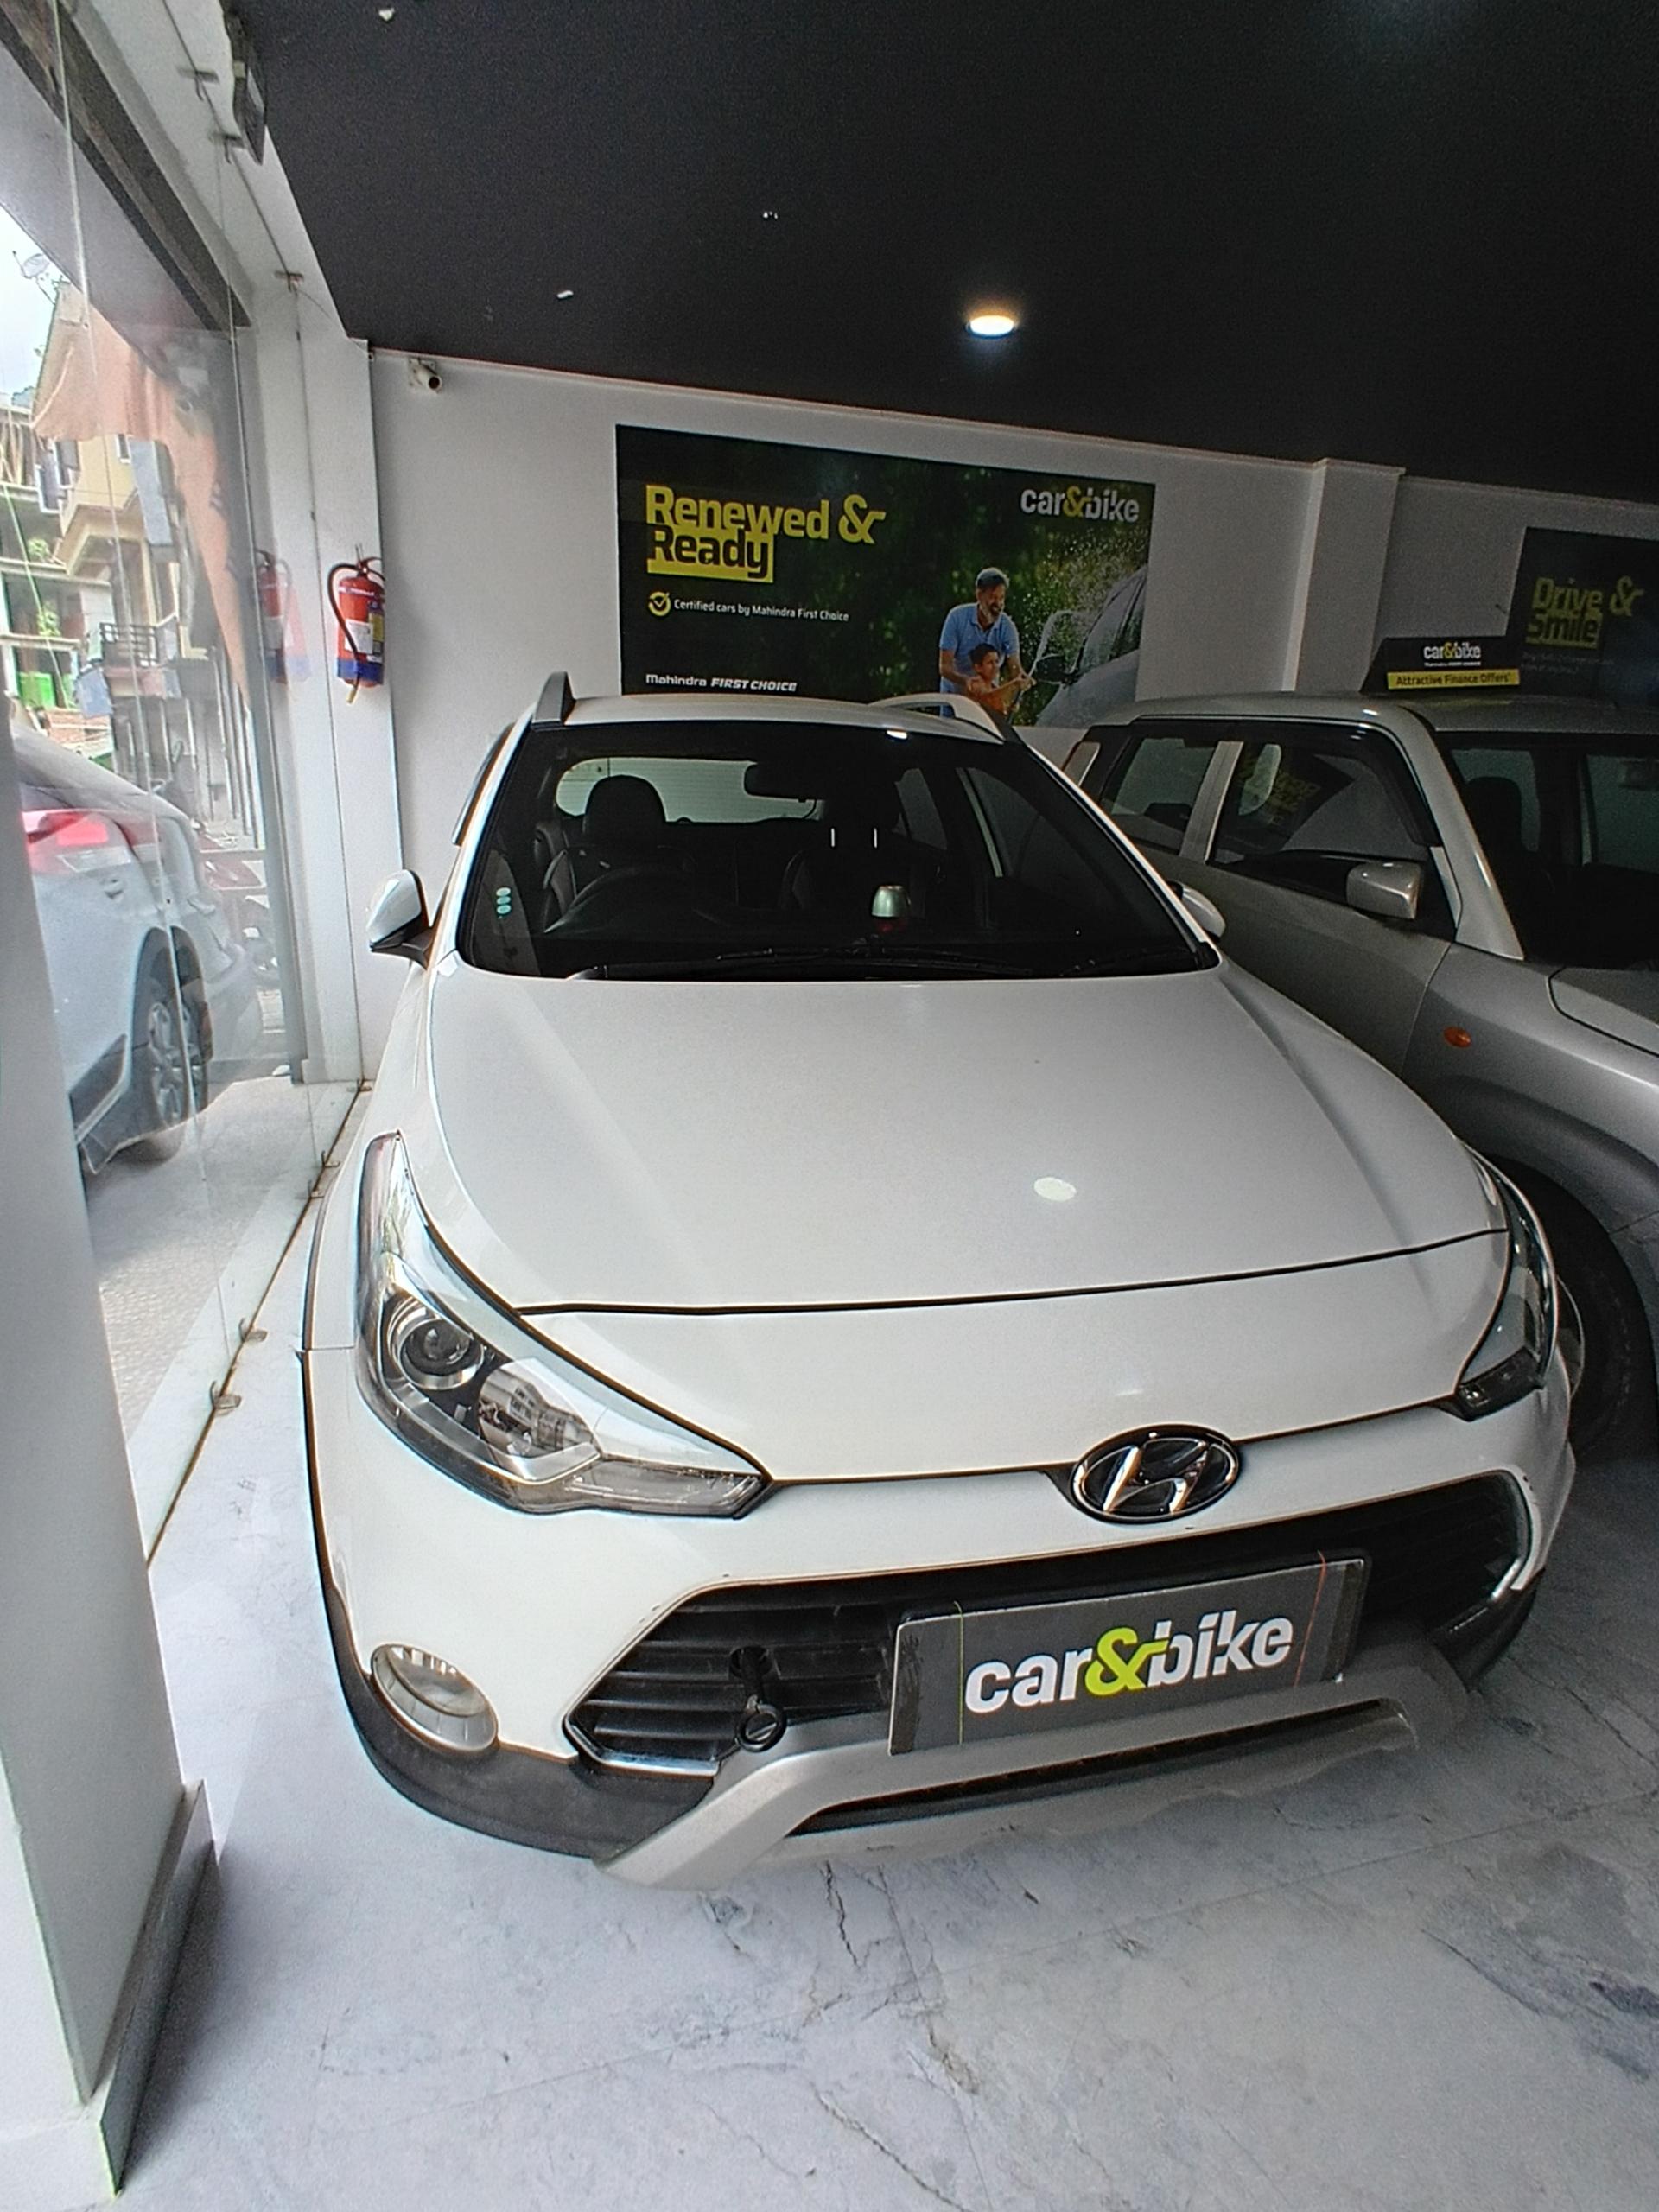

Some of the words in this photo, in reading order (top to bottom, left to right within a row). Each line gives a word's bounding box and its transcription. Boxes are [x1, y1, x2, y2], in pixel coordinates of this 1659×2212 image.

[645, 485, 830, 540] Renewed
[838, 493, 887, 545] &
[1020, 486, 1141, 523] car&bike
[648, 524, 769, 580] Ready
[673, 598, 715, 613] Certified
[715, 603, 736, 613] cars
[737, 603, 751, 617] by
[752, 605, 796, 618] Mahindra
[798, 607, 818, 620] First
[819, 609, 849, 621] Choice
[1532, 576, 1604, 611] Drive
[1609, 575, 1645, 618] &
[710, 677, 749, 690] FIRST
[750, 679, 798, 692] CHOICE
[1395, 674, 1442, 686] Attractive
[1444, 673, 1478, 685] Finance
[963, 1609, 1294, 1714] car&bike
